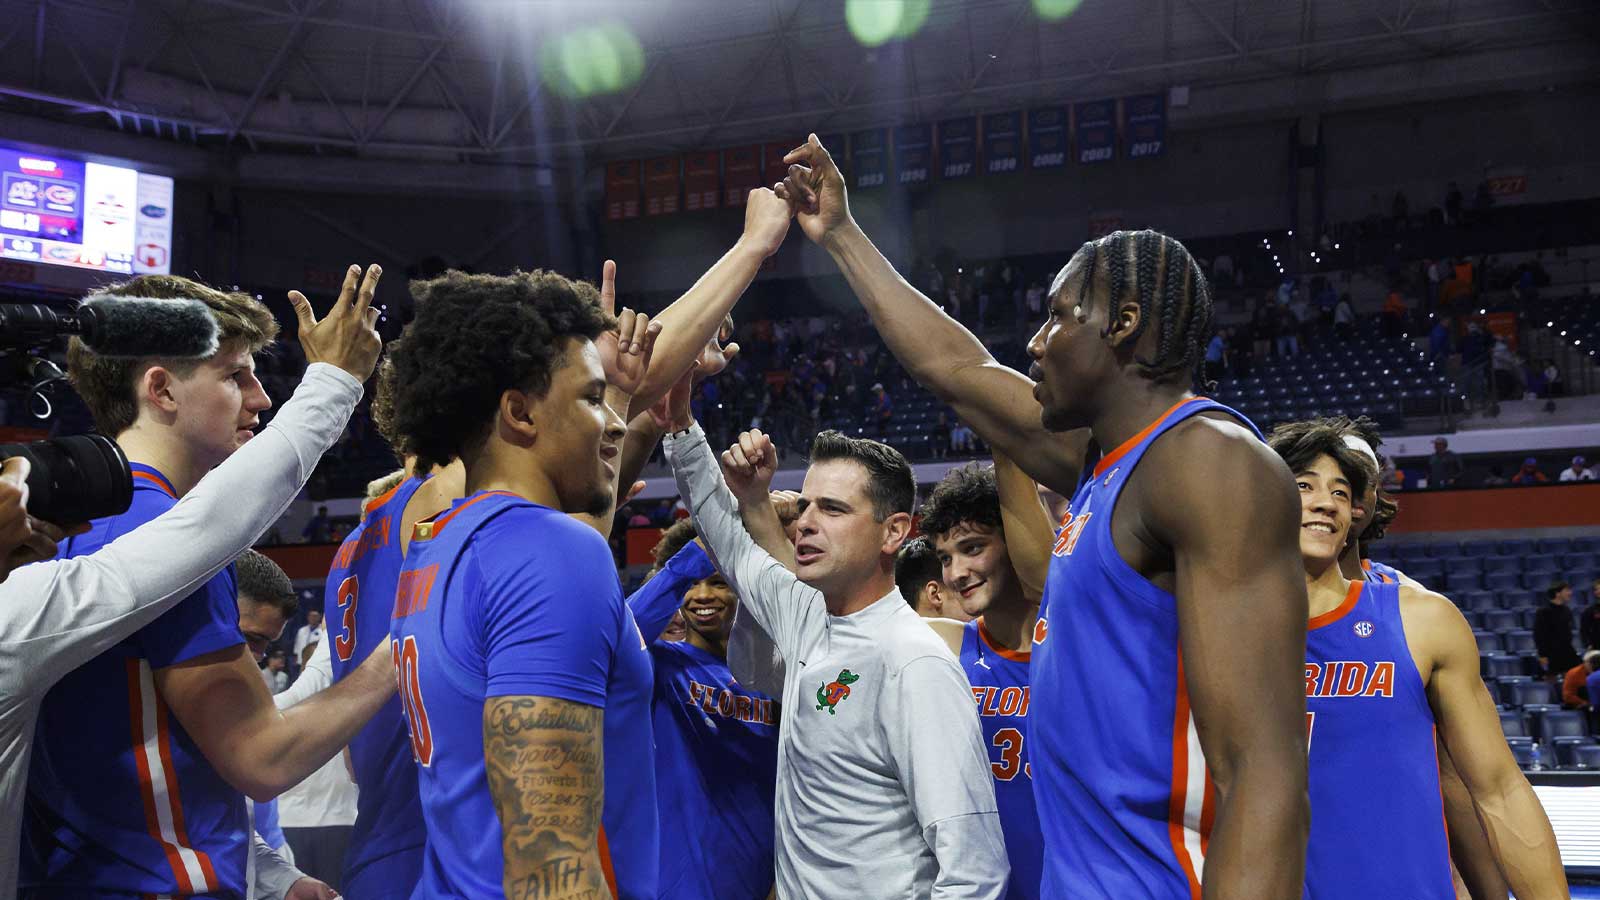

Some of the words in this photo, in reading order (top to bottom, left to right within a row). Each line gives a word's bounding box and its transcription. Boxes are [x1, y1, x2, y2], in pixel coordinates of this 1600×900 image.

[1130, 142, 1161, 157] 2017
[334, 573, 360, 662] 3
[1354, 622, 1373, 636] SEC
[510, 856, 585, 900] FAITH
